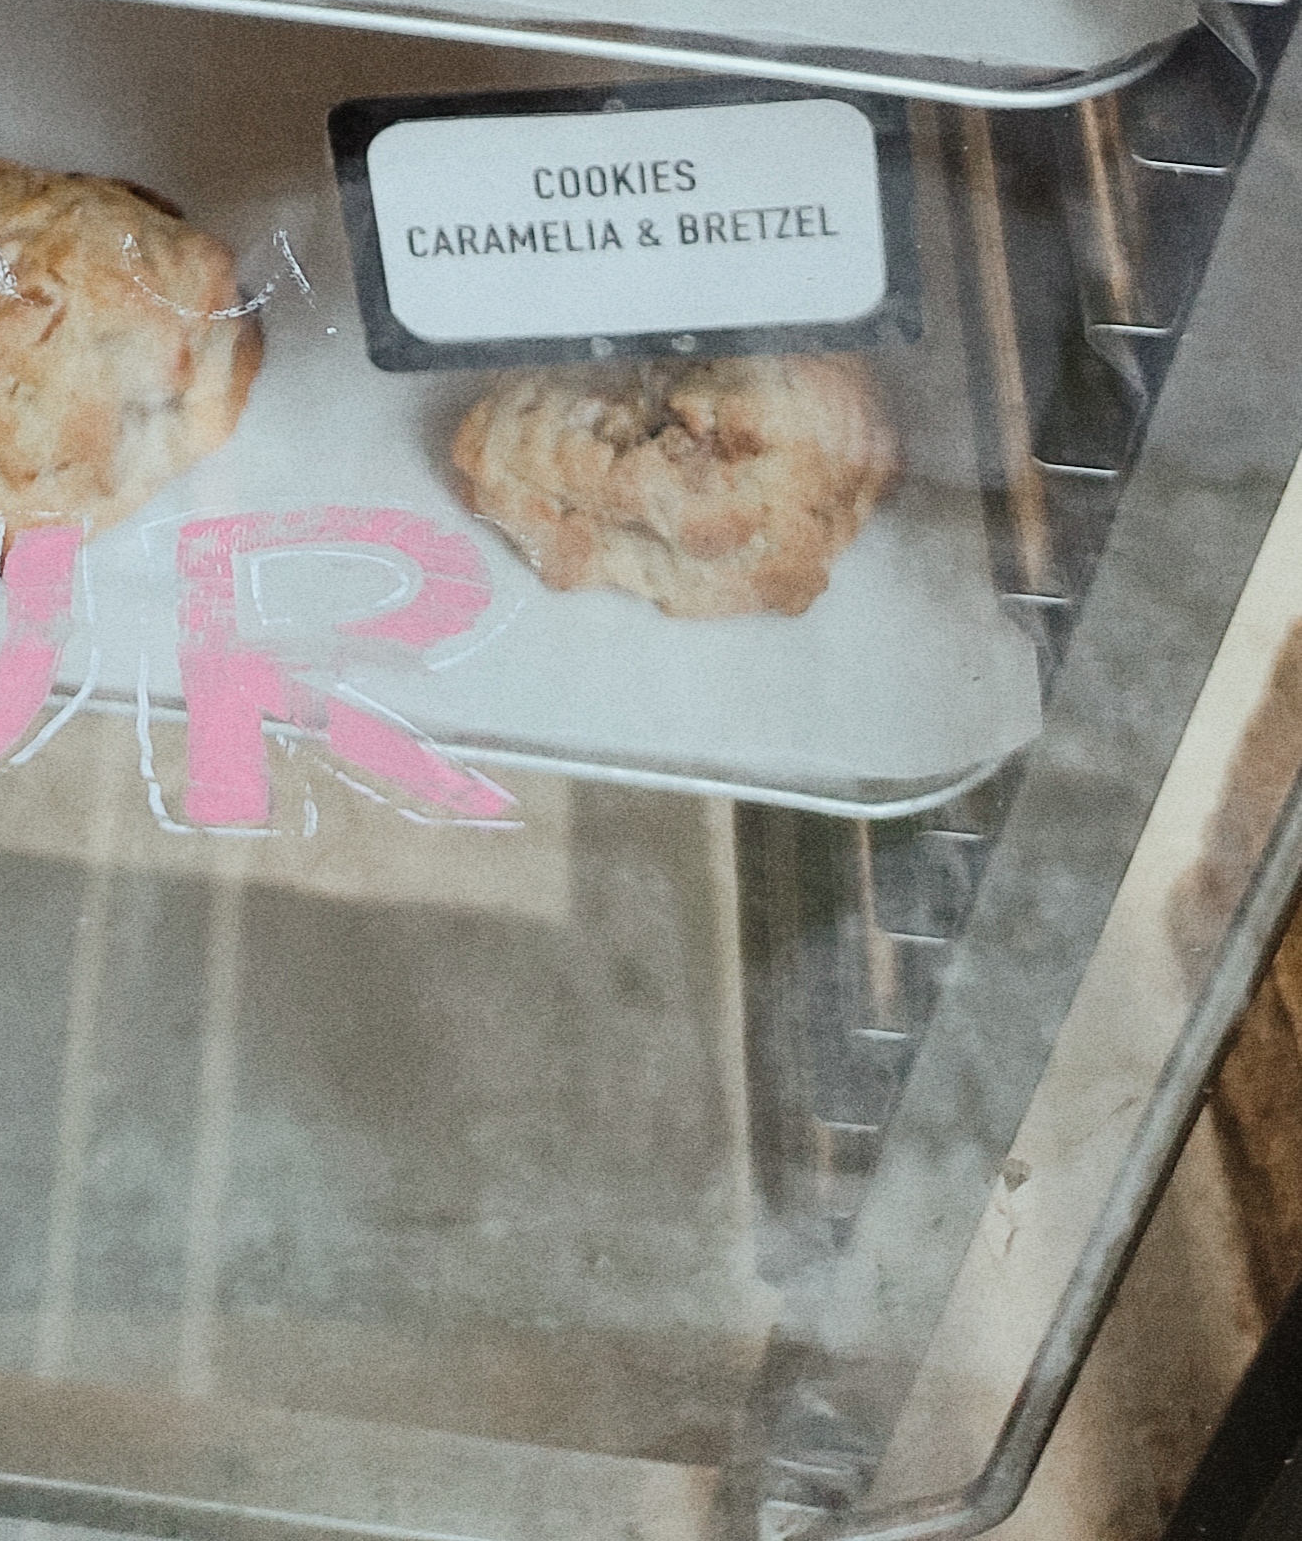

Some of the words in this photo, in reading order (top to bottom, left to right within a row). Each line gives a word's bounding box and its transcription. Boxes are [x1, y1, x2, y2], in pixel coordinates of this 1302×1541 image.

[533, 158, 697, 200] COOKIES
[406, 217, 623, 258] CARAMELIA
[638, 217, 661, 247] &
[677, 204, 840, 246] BRETZEL
